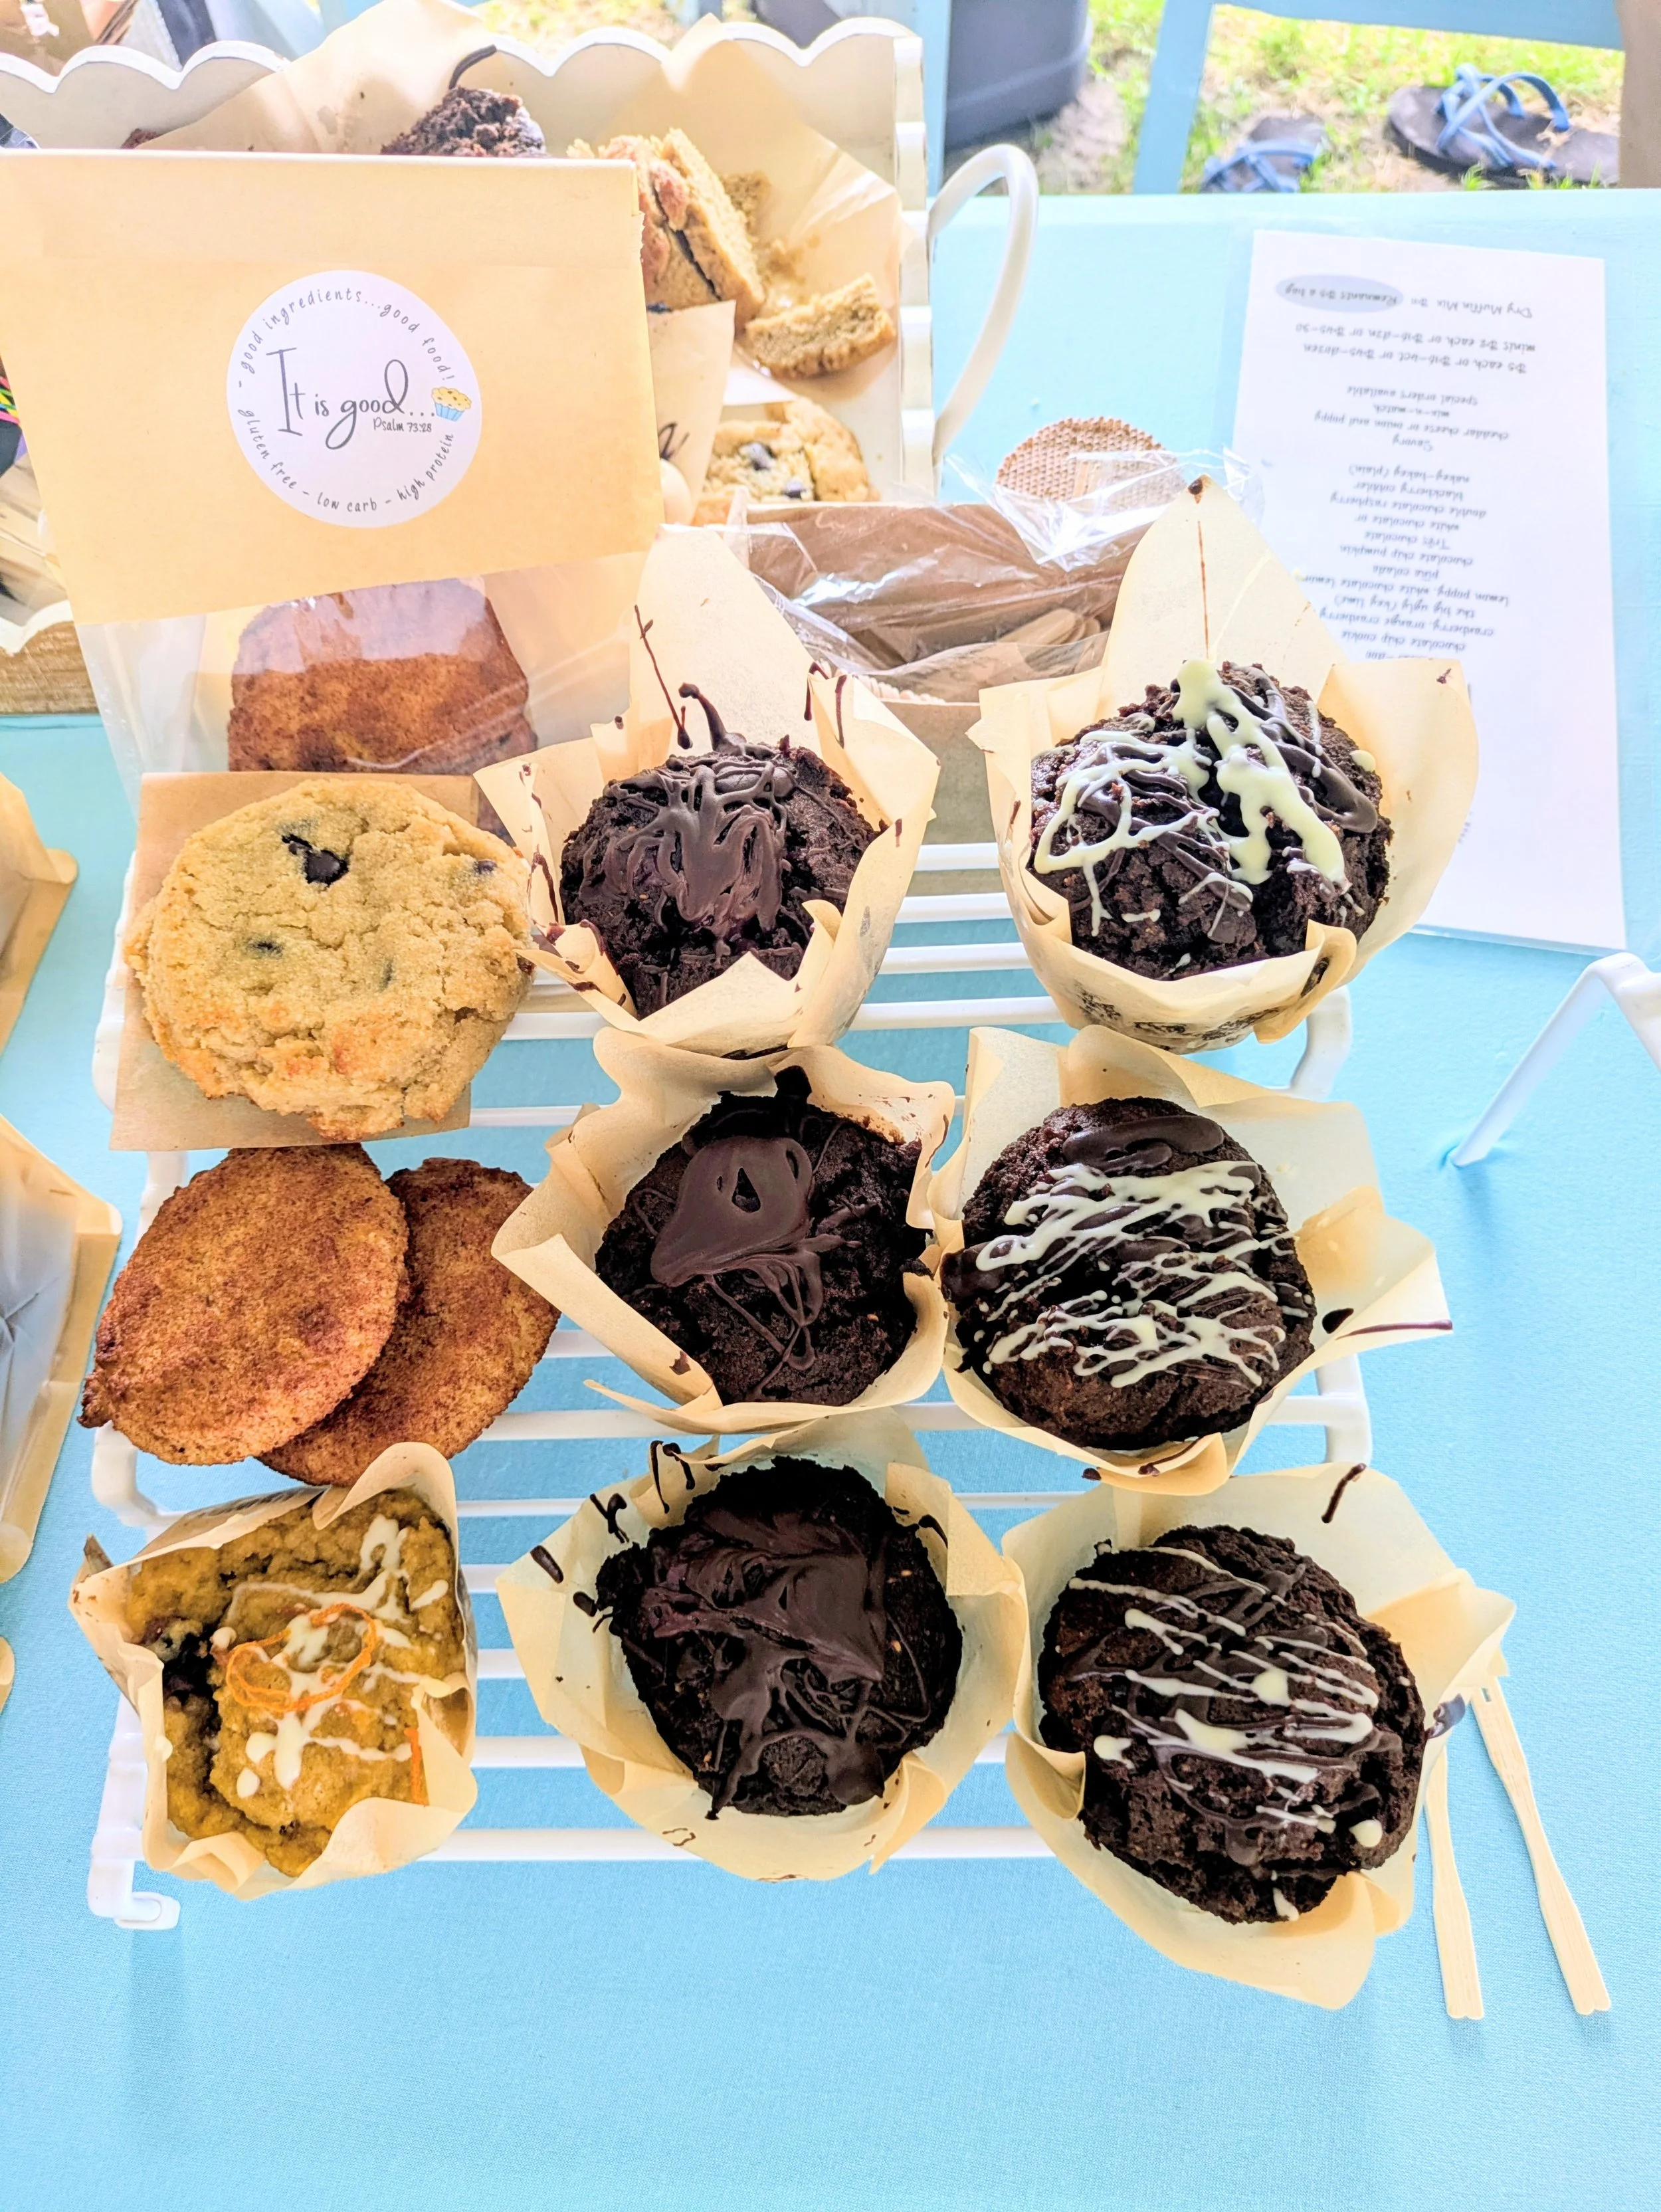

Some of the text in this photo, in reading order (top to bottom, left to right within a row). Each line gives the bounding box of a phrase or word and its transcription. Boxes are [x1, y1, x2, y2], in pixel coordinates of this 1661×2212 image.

[1285, 283, 1305, 297] bag
[1340, 291, 1397, 307] Remnants
[1437, 300, 1458, 311] Mix
[1462, 300, 1502, 316] Muffin
[1506, 302, 1532, 318] Dry
[1349, 328, 1363, 338] or
[1427, 334, 1441, 343] or
[1446, 336, 1474, 348] each
[1503, 341, 1535, 354] minis
[241, 330, 265, 375] good
[422, 336, 455, 382] food!
[1379, 350, 1393, 360] or
[1455, 358, 1469, 367] or
[1473, 358, 1502, 371] each
[1507, 362, 1526, 374] $5
[266, 347, 306, 437] It
[314, 393, 330, 417] is
[1347, 385, 1478, 407] special orders available
[1373, 403, 1449, 419] mix-n-match
[373, 417, 433, 433] Psalm 73:28
[1314, 410, 1508, 442] cheddar cheese or onion and poppy
[1392, 433, 1432, 452] Savory
[238, 407, 270, 460] gluten
[272, 460, 298, 490] free
[317, 491, 340, 511] low
[346, 497, 377, 513] carb
[397, 477, 425, 501] high
[425, 433, 454, 481] protein
[1348, 463, 1388, 478] (plain)
[1353, 481, 1462, 501] blackberry cobbler
[1330, 493, 1486, 520] double chocolate raspberry
[1355, 514, 1458, 533] white chocolate or
[1365, 531, 1417, 546] chocolate
[1340, 544, 1473, 567] chocolate chip pumpkin
[1372, 565, 1409, 579] colada
[1340, 577, 1393, 594] chocolate
[1399, 583, 1428, 598] white
[1333, 593, 1474, 621] the big ugly (key lime)
[1476, 593, 1509, 607] lemon
[1319, 607, 1379, 627] cranberry
[1385, 615, 1424, 631] orange
[1341, 629, 1465, 654] chocolate chip cookie
